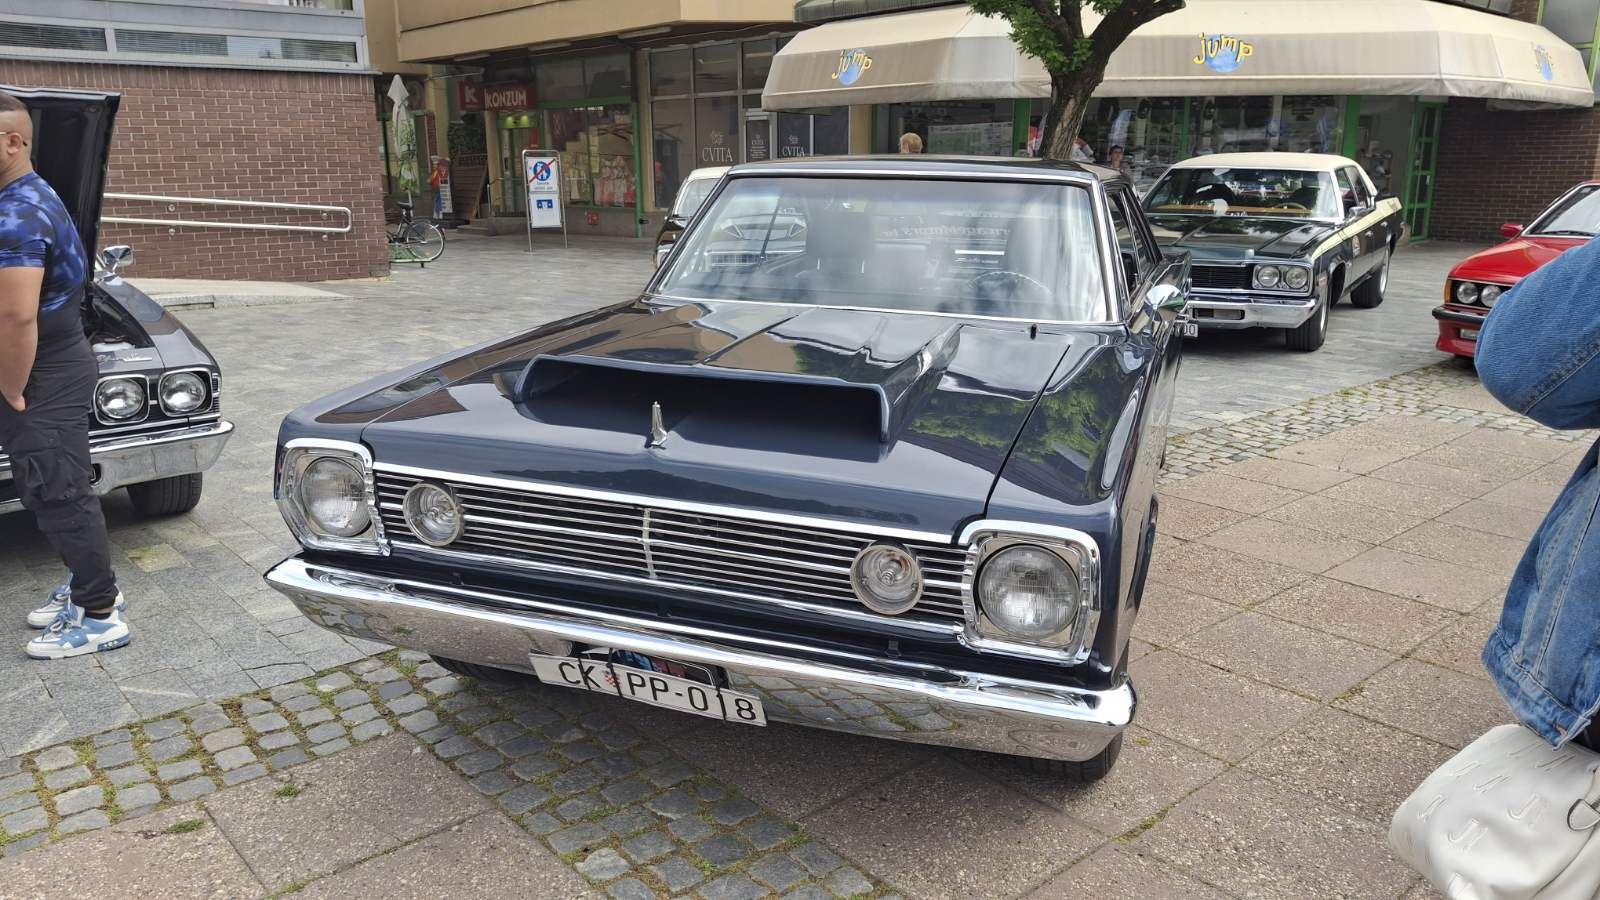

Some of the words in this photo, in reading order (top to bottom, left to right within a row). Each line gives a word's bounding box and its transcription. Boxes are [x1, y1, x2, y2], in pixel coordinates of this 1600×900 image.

[1193, 32, 1254, 65] jump
[831, 48, 873, 79] jump
[464, 86, 478, 103] K
[484, 88, 527, 108] KONZUM
[702, 147, 733, 162] CVITA
[782, 146, 805, 157] CVITA
[558, 662, 601, 689] CK
